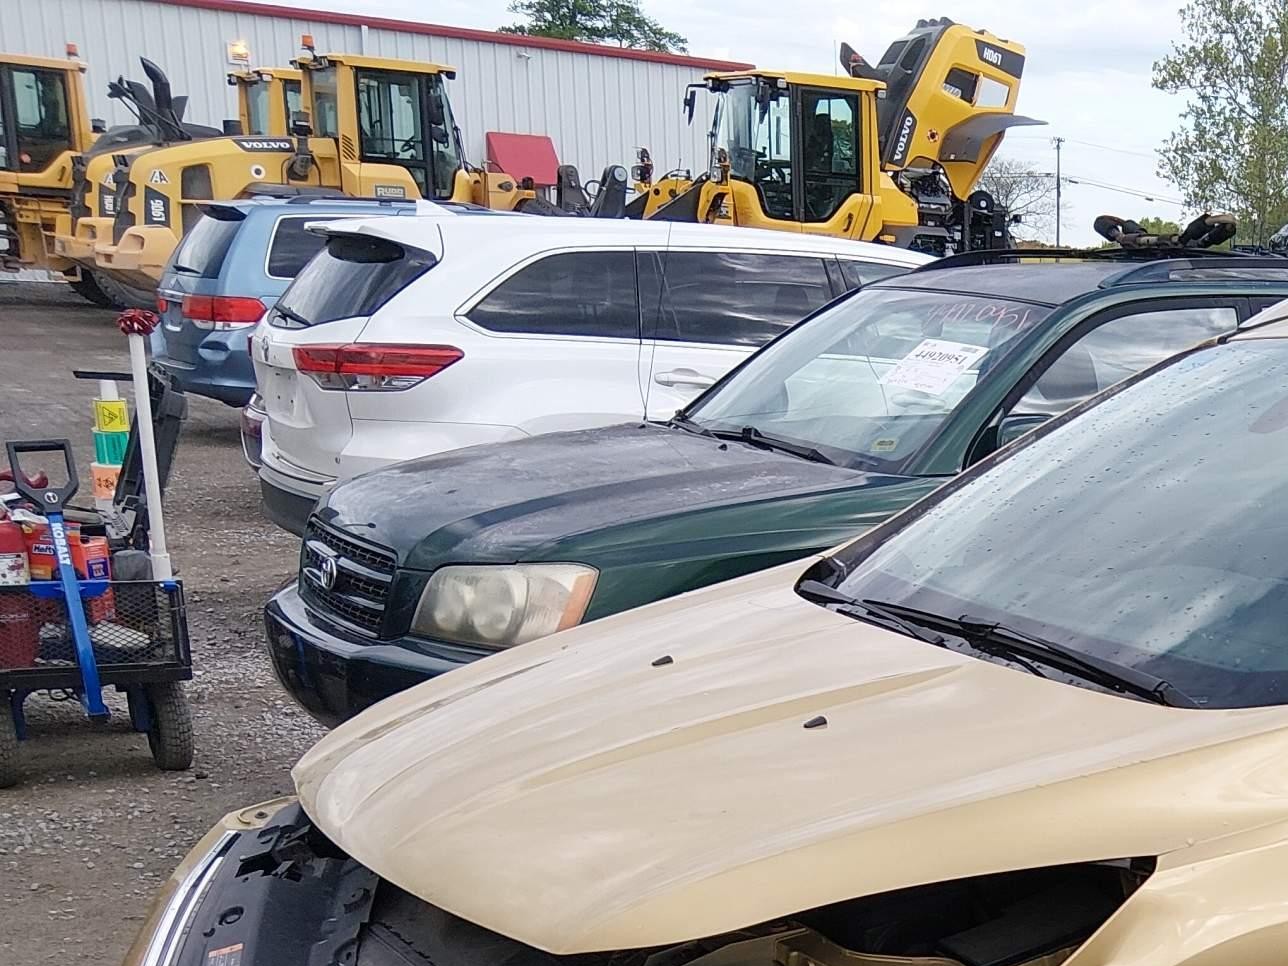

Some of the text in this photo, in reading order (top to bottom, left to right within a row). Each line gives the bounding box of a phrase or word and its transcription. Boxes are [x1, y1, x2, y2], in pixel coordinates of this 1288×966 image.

[241, 140, 291, 150] VOLVO
[893, 115, 914, 161] VOLVO
[52, 523, 71, 565] KOBALT
